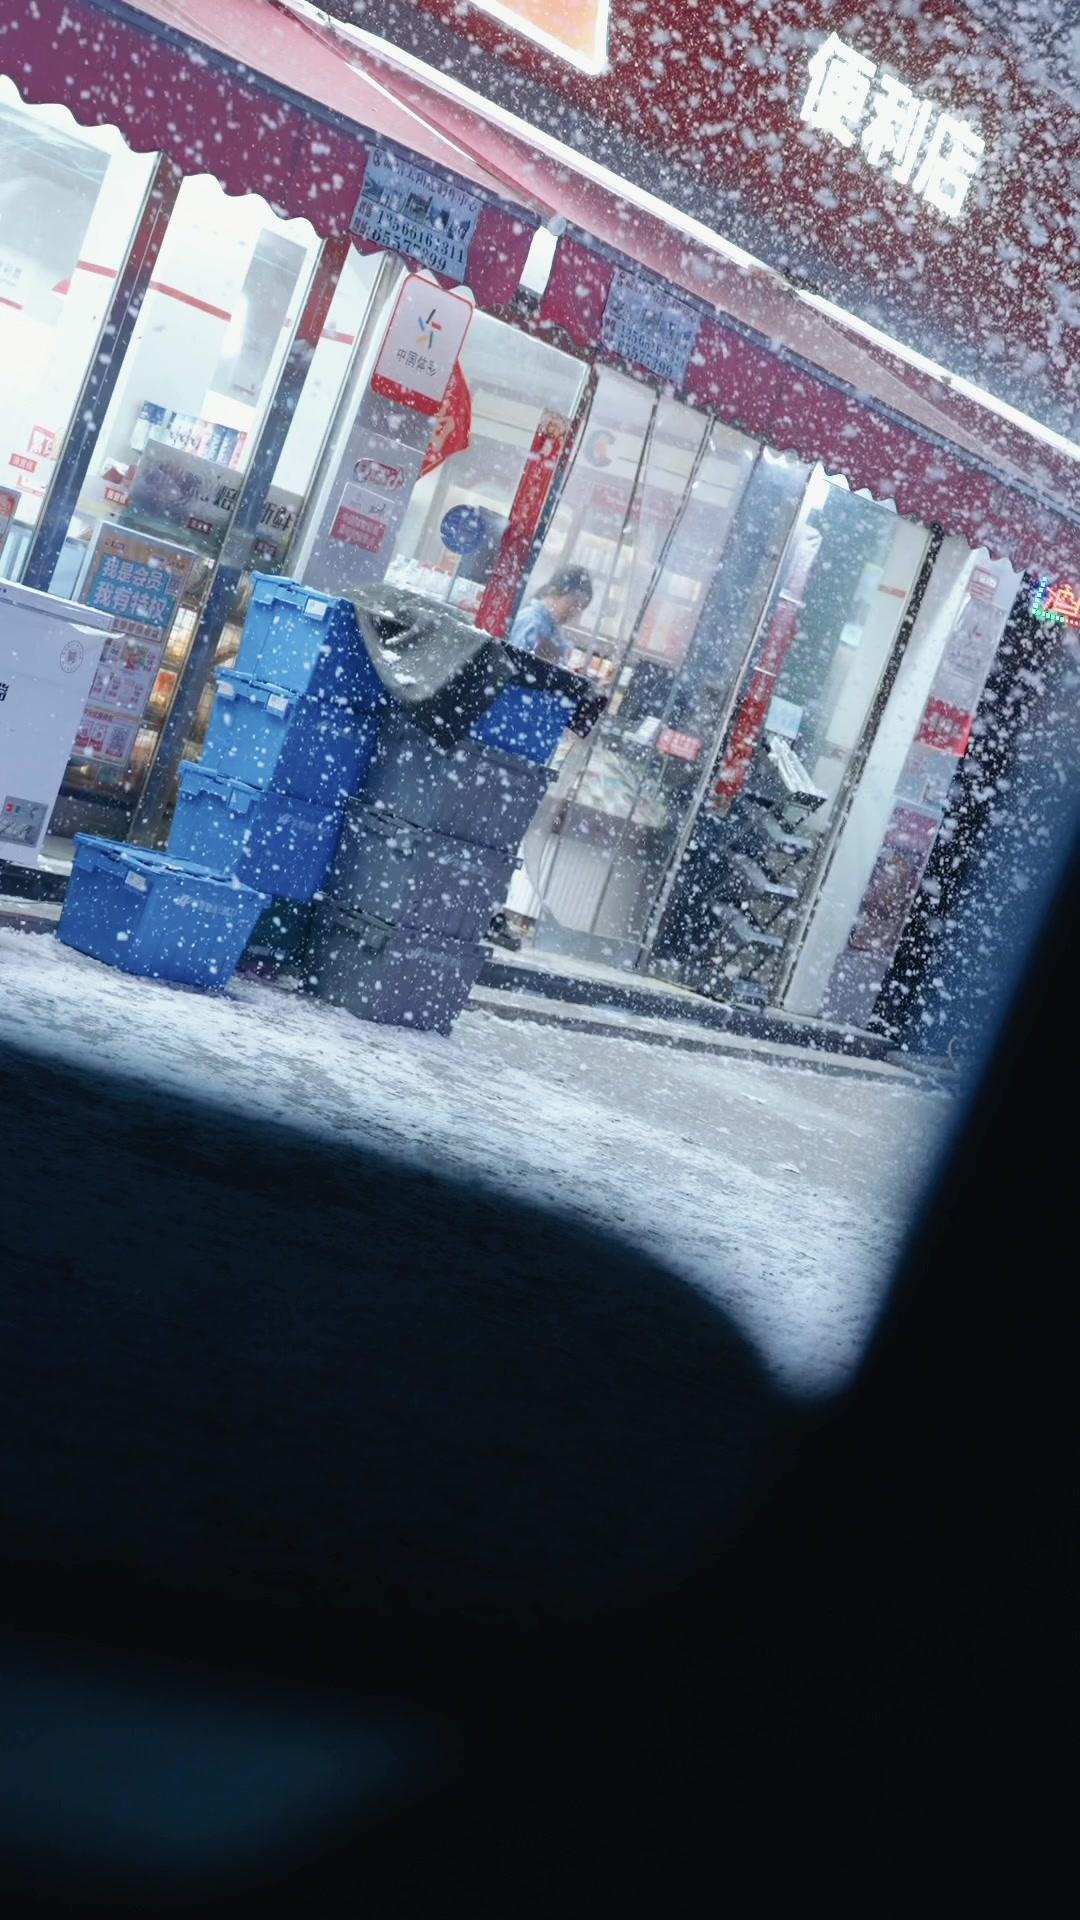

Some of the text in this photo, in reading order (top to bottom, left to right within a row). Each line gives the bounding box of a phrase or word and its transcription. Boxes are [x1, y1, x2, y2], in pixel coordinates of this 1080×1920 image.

[800, 31, 985, 218] 便利店
[395, 347, 439, 376] 中国体彩
[102, 555, 164, 590] 我是会员
[93, 578, 167, 621] 我有特权
